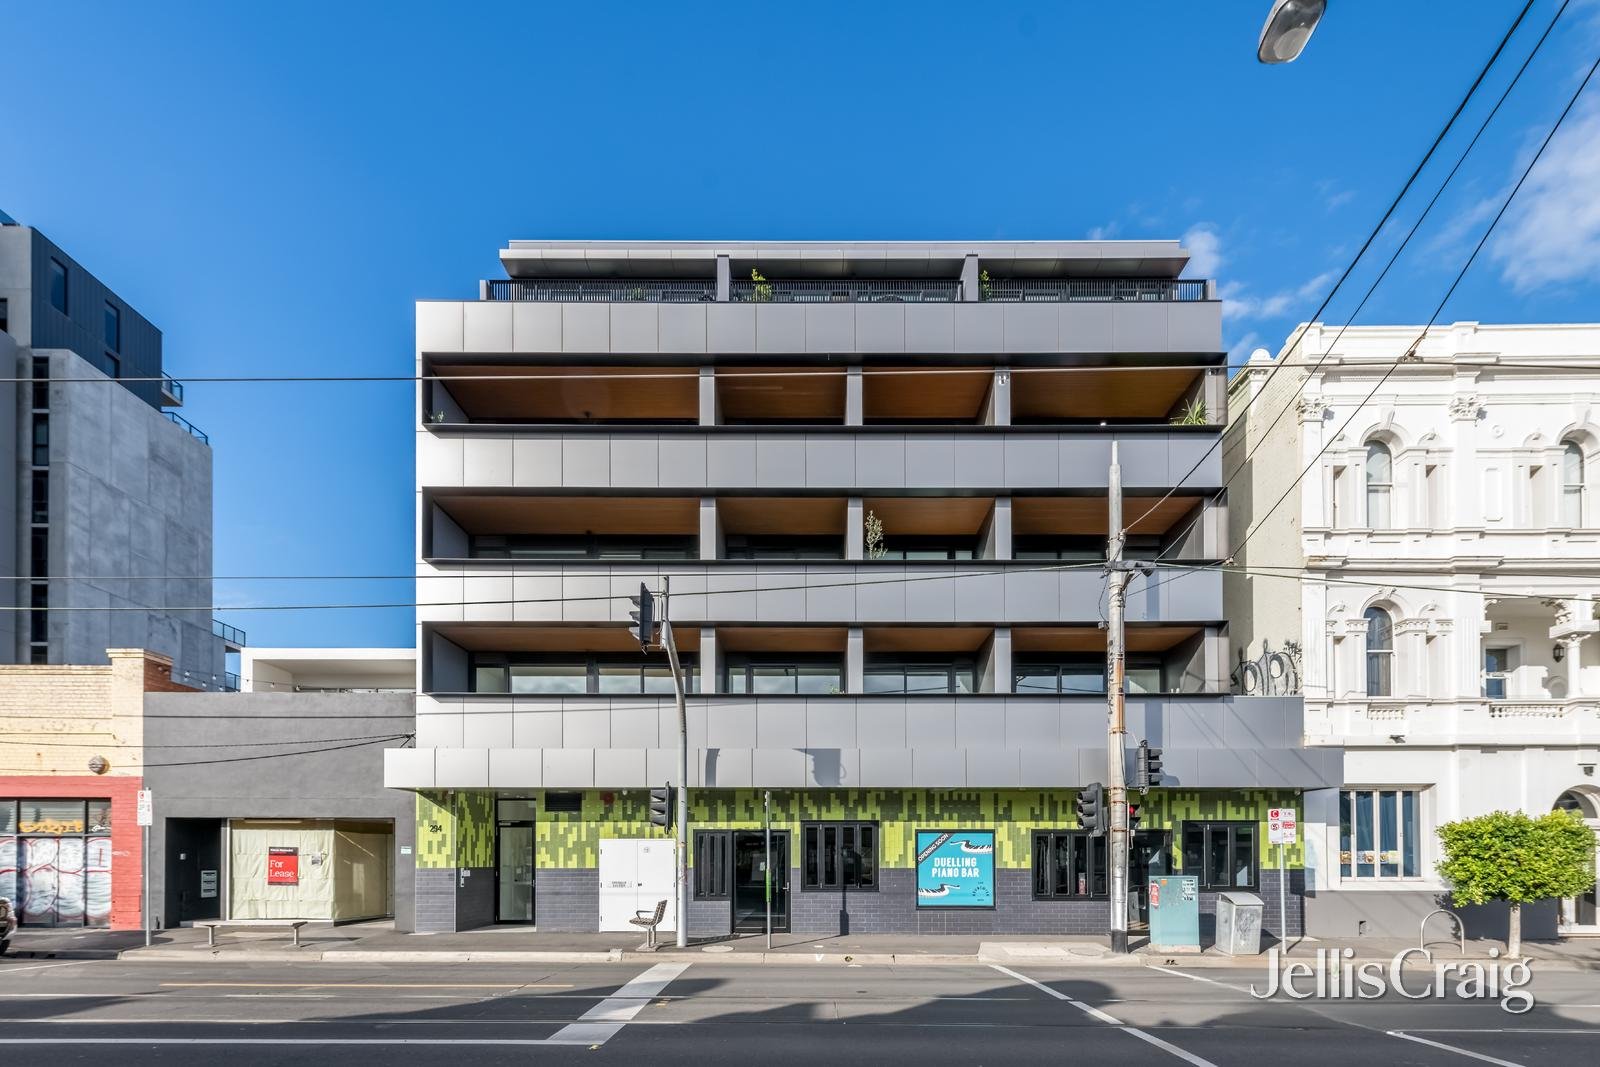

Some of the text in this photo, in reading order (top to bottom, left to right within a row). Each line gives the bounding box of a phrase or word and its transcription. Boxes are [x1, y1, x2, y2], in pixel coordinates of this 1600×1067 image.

[429, 825, 442, 833] 294
[917, 833, 949, 861] OPENING SOON
[269, 859, 285, 869] For
[934, 857, 977, 867] DUELLING
[269, 869, 295, 878] Lease
[931, 867, 980, 878] PIANO BAR
